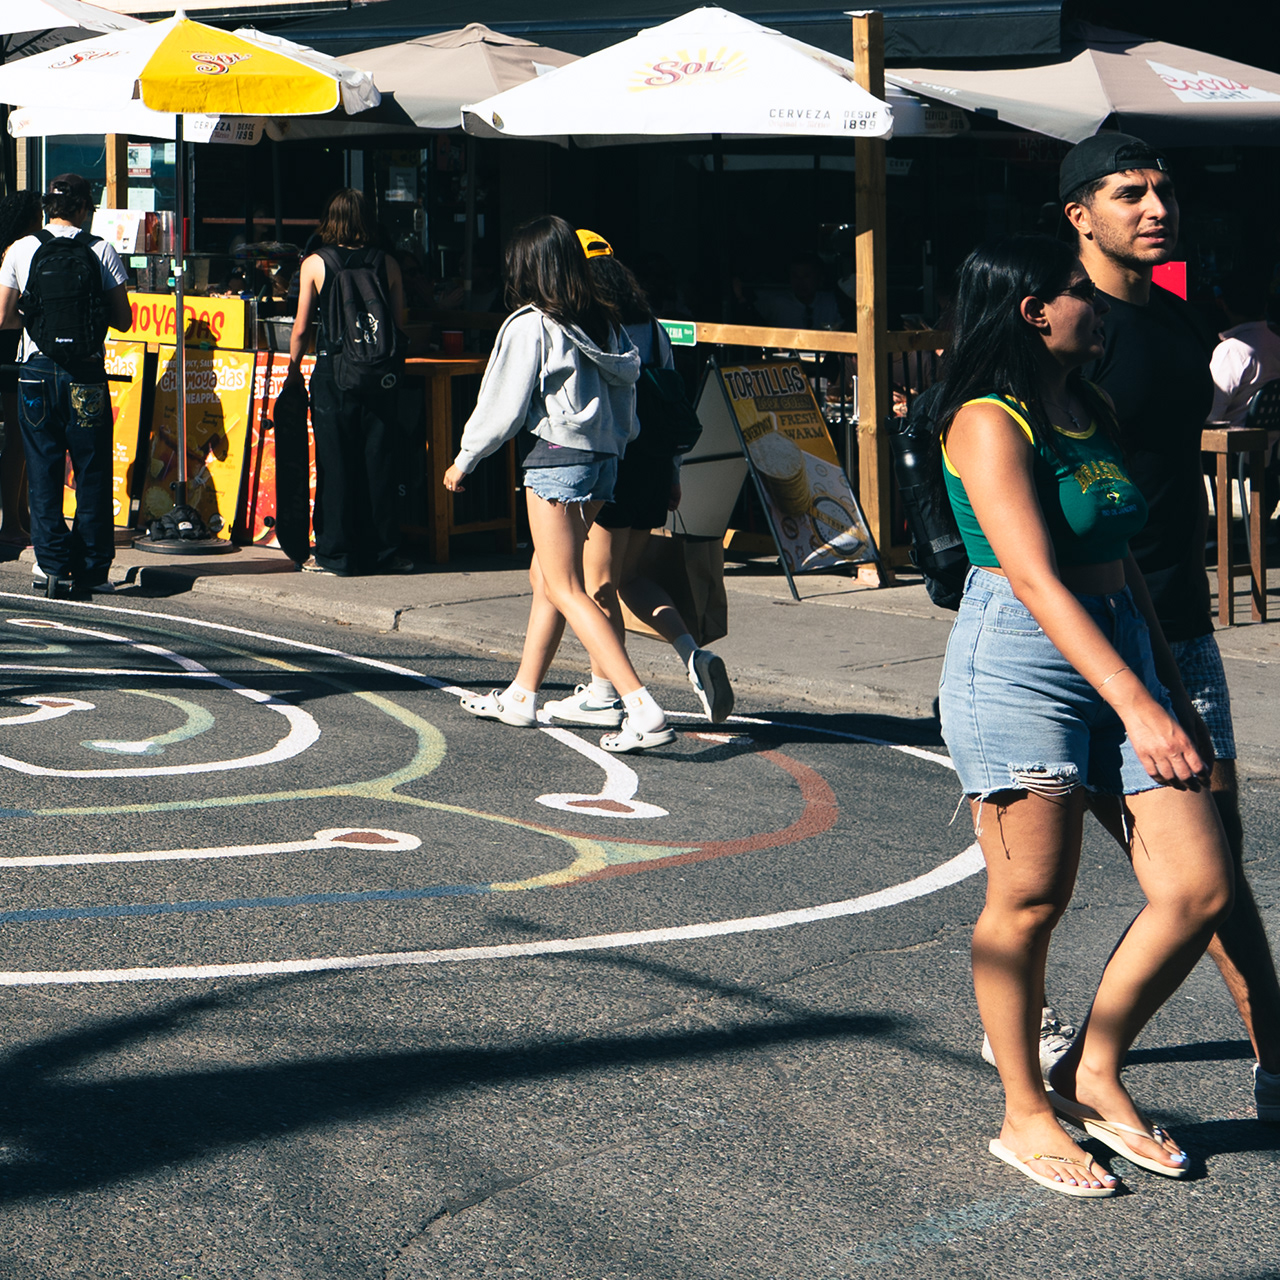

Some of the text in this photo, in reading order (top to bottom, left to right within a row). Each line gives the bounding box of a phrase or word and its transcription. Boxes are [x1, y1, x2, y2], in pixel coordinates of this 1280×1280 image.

[644, 59, 725, 86] SOL
[769, 107, 878, 120] CERVEZA DESDE
[193, 120, 232, 133] CERVEZA
[842, 119, 877, 131] 1899
[724, 366, 807, 401] TORTILLAS
[185, 392, 222, 404] NEAPPLE
[779, 412, 819, 426] FRESH
[784, 428, 825, 441] WARM
